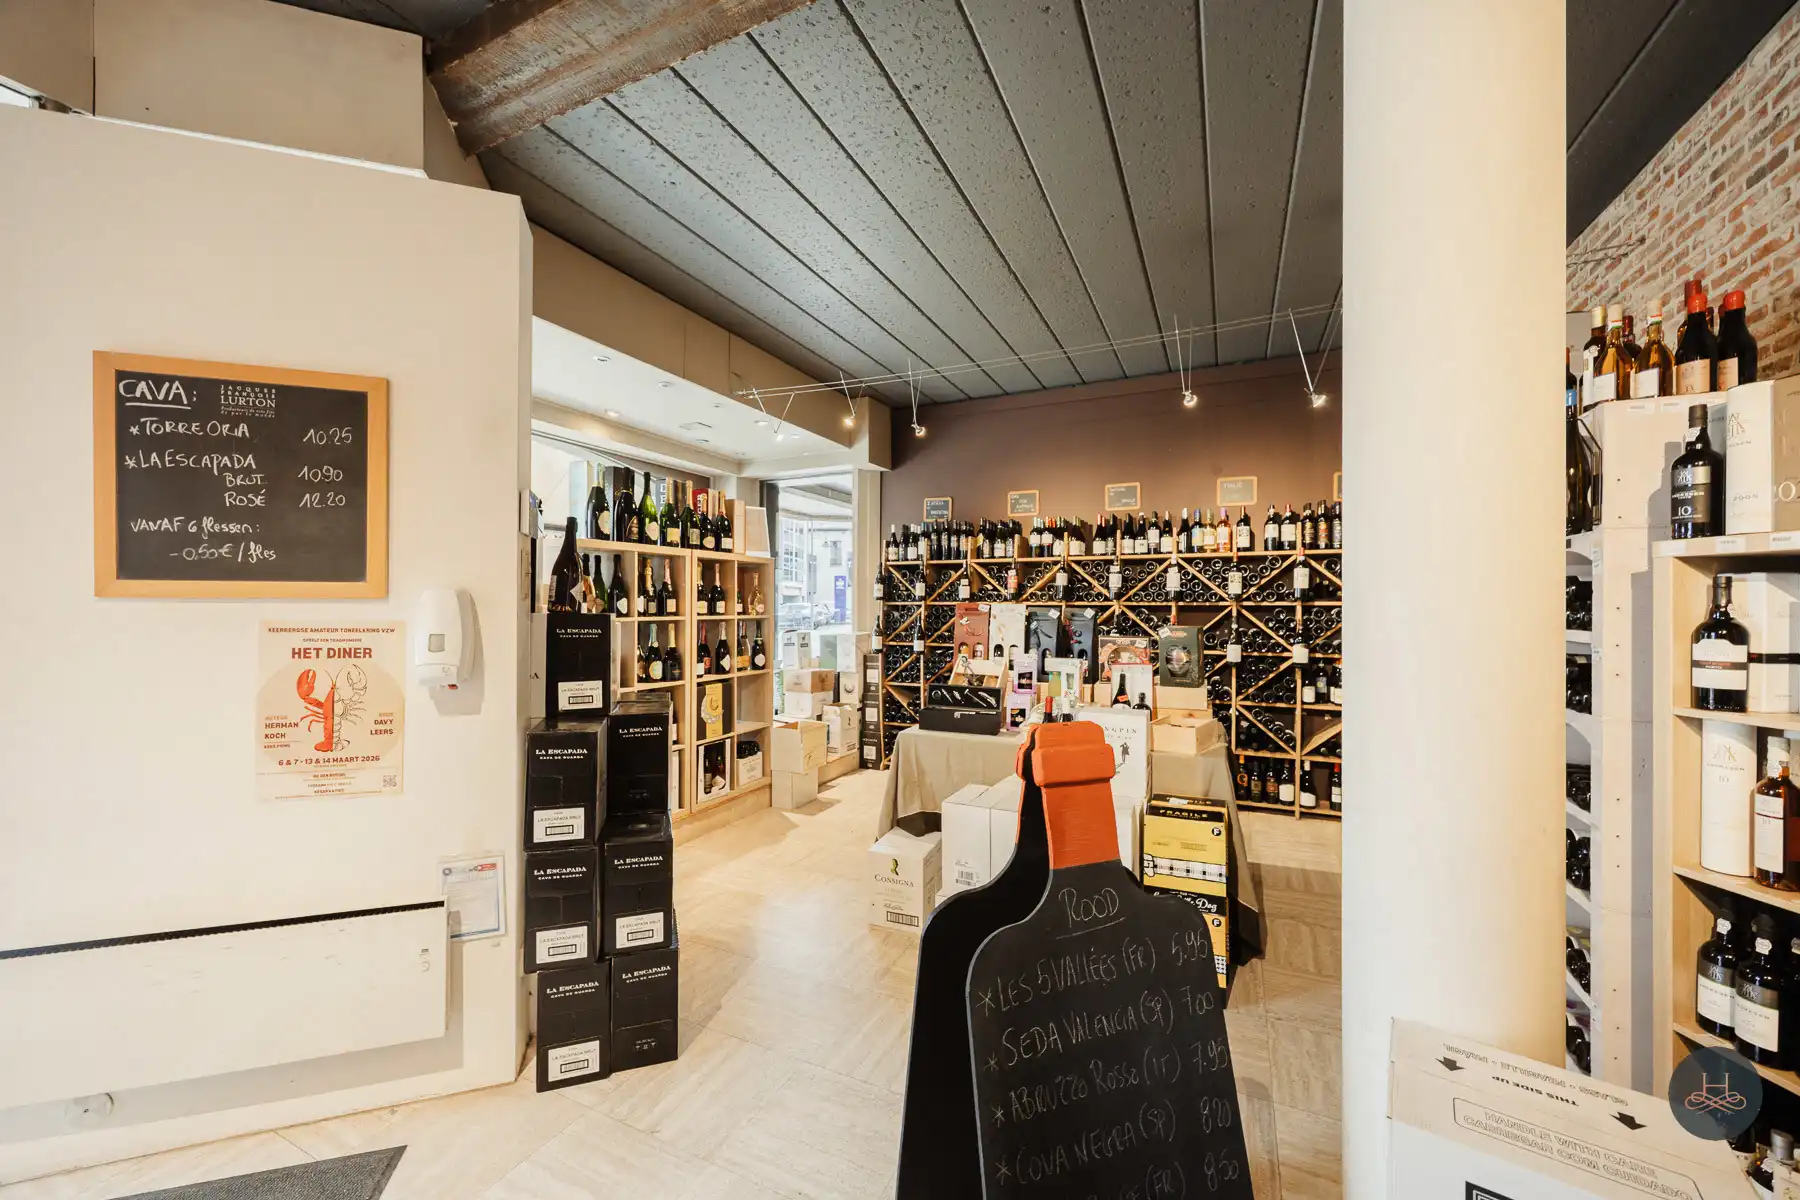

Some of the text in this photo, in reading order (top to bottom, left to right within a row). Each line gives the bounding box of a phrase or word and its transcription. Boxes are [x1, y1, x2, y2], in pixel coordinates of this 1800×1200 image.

[221, 396, 276, 408] LURTON
[140, 417, 352, 445] TORRE ORIA 10.25
[224, 489, 347, 509] ROSÉ 12.20
[130, 516, 184, 533] VANAF
[187, 519, 197, 533] 6
[291, 647, 373, 659] HET DINER
[264, 722, 299, 730] HERMAN
[370, 728, 394, 736] LEERS
[264, 732, 286, 740] KOCH
[1160, 809, 1208, 818] FRAGILE
[625, 856, 663, 864] ESCAPADA
[546, 866, 587, 875] ESCAPADA
[874, 874, 914, 887] CONSIGNA
[1058, 887, 1120, 927] ROOD
[1196, 898, 1217, 912] Dog
[633, 965, 671, 976] ESCAPADA
[559, 981, 600, 992] ESCAPADA
[998, 974, 1033, 1012] LES
[1003, 1022, 1063, 1066] SEDA
[1491, 1076, 1580, 1107] UP SIDE THIS
[1579, 1085, 1628, 1107] GLASS
[1463, 1115, 1553, 1155] CARREGAR
[1557, 1148, 1600, 1170] COM
[1484, 1111, 1657, 1180] HANDLE WITH CARE
